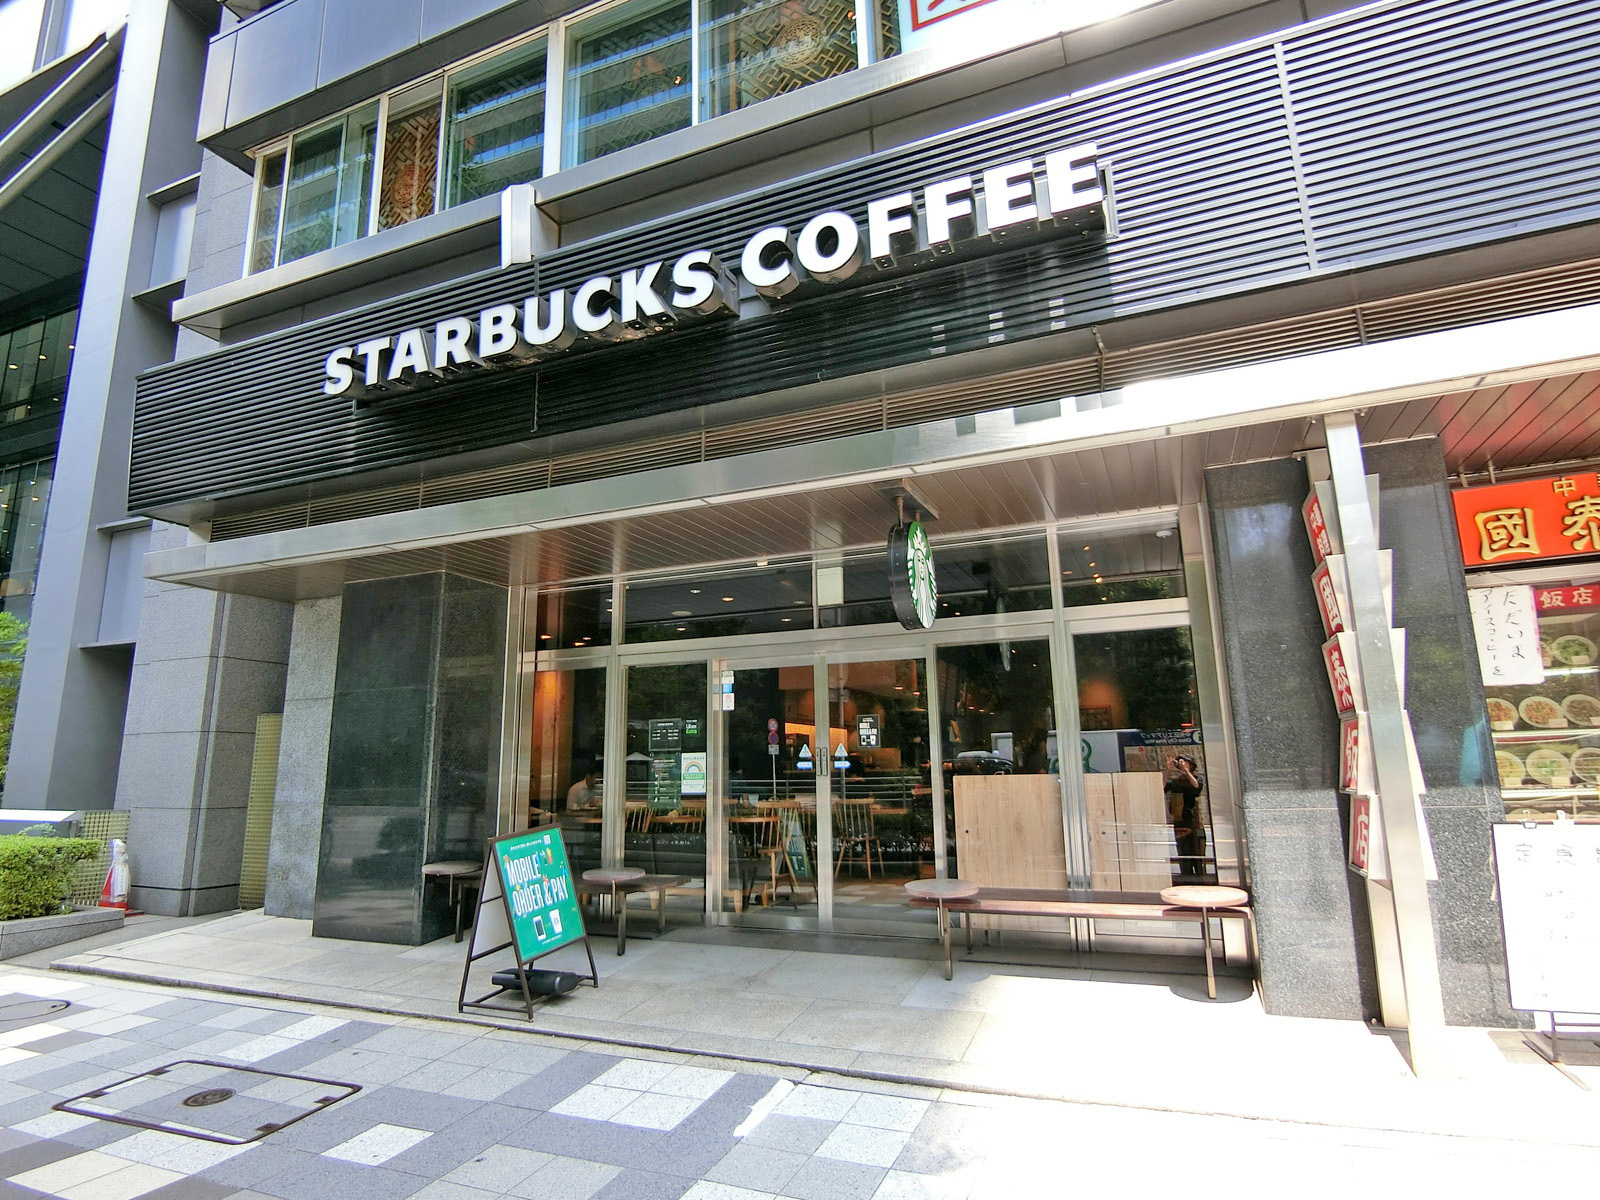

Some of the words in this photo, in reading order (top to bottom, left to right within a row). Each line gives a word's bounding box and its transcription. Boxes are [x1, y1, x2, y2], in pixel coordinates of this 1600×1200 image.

[322, 249, 714, 396] STARBUCKS
[741, 141, 1104, 287] COFFEE
[1540, 587, 1594, 609] 飯店
[506, 853, 541, 886] MOBILE
[512, 883, 545, 916] ORDER
[543, 880, 553, 905] &
[551, 875, 569, 902] PAY
